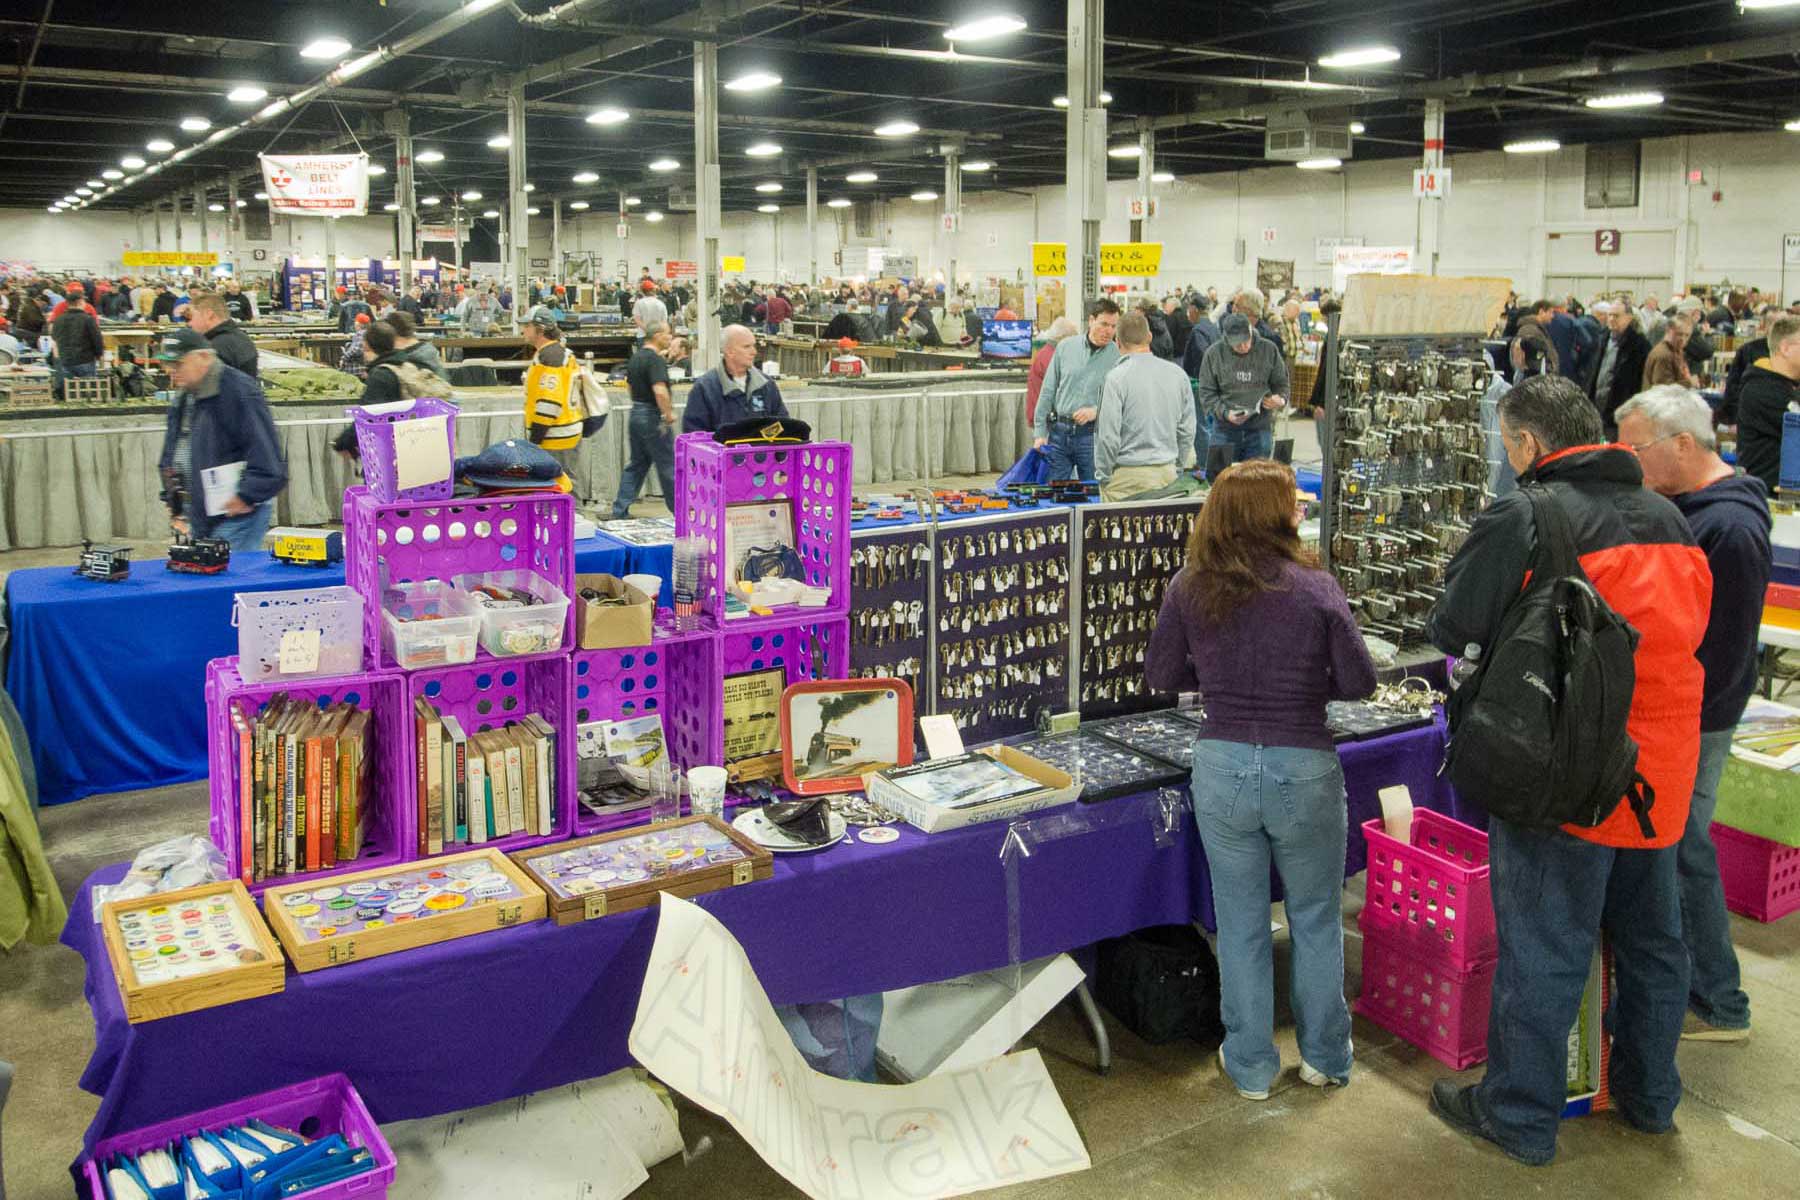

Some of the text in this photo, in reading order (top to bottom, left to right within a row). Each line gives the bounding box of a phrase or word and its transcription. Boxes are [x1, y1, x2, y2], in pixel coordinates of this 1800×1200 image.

[1420, 174, 1436, 192] 14
[1131, 201, 1142, 215] 13
[1600, 232, 1613, 250] 2
[255, 250, 264, 260] 9
[1129, 250, 1143, 260] &
[286, 744, 294, 839] TRAINS AROUND THE WORLD
[322, 758, 331, 834] IRON HORSES
